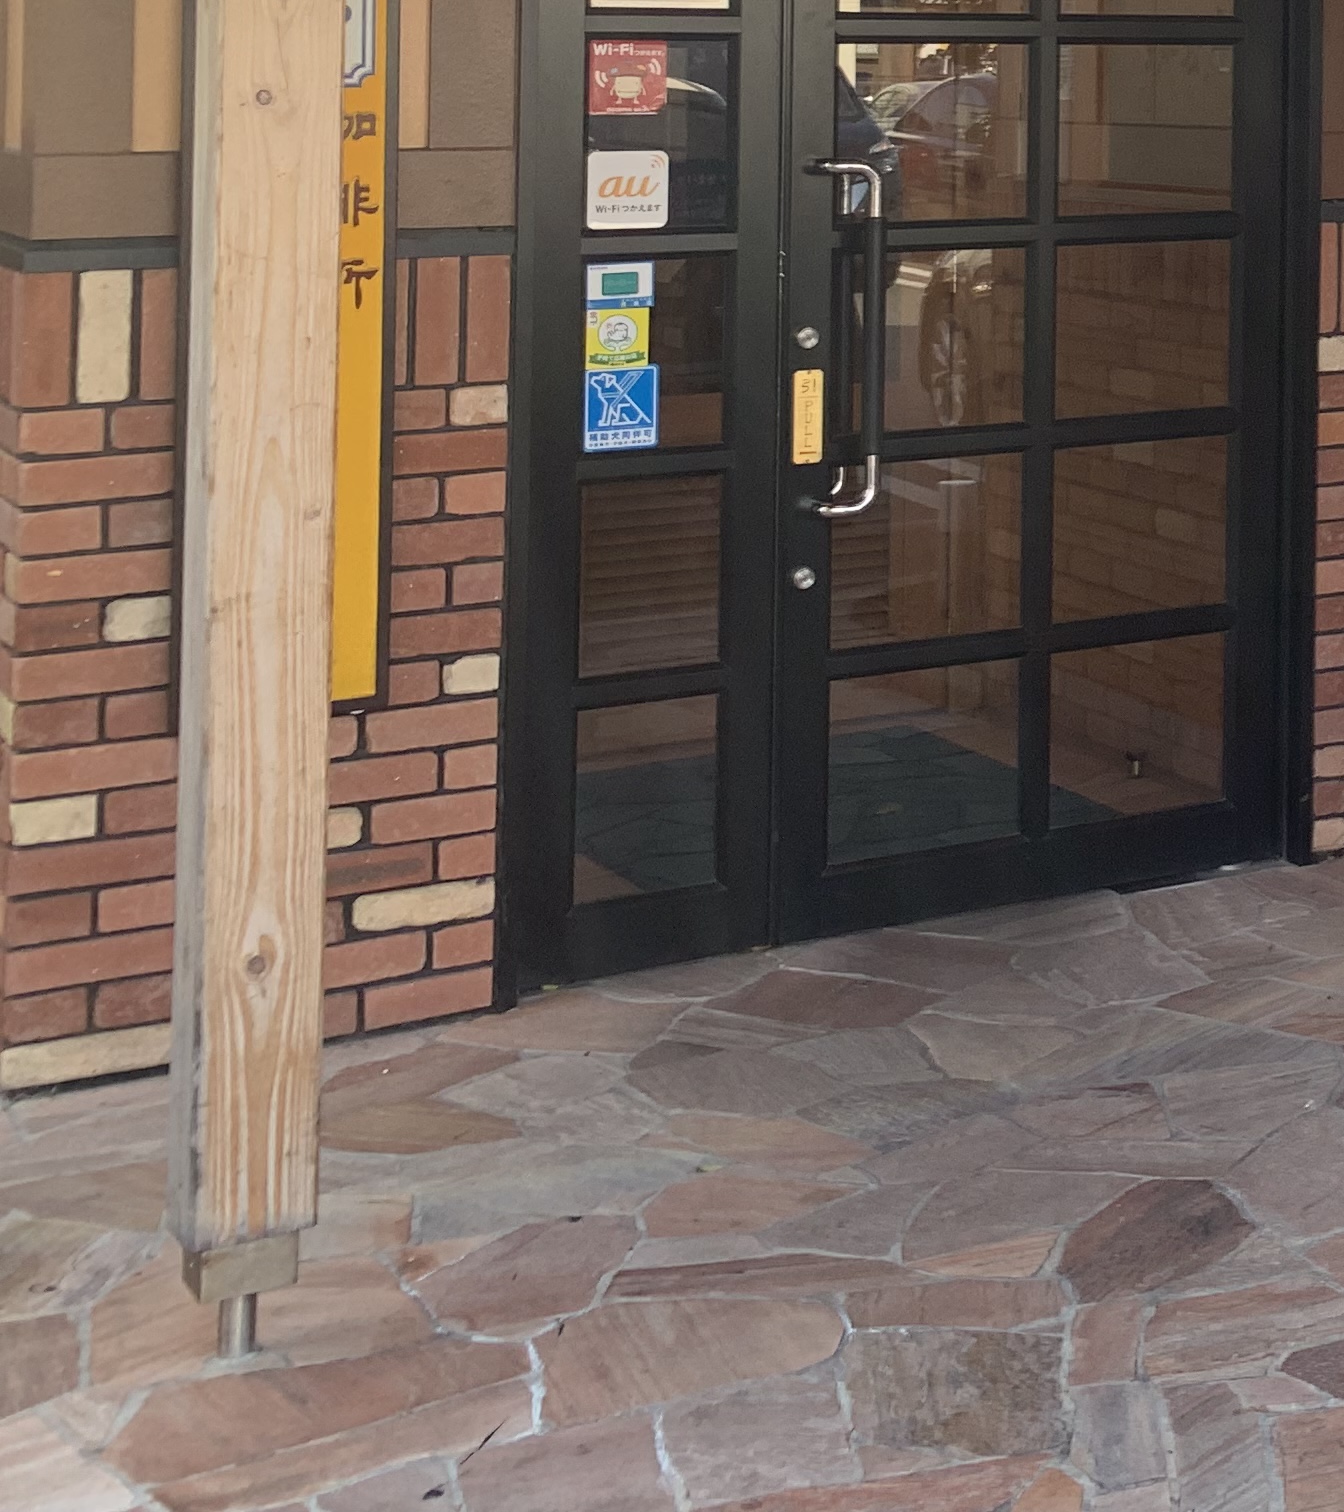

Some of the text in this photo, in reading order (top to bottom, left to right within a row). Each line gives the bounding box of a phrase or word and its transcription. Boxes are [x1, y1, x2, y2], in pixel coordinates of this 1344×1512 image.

[593, 42, 634, 56] Wi-Fi
[598, 175, 660, 198] au
[595, 204, 620, 213] Wi-Fi
[804, 400, 814, 448] PULL
